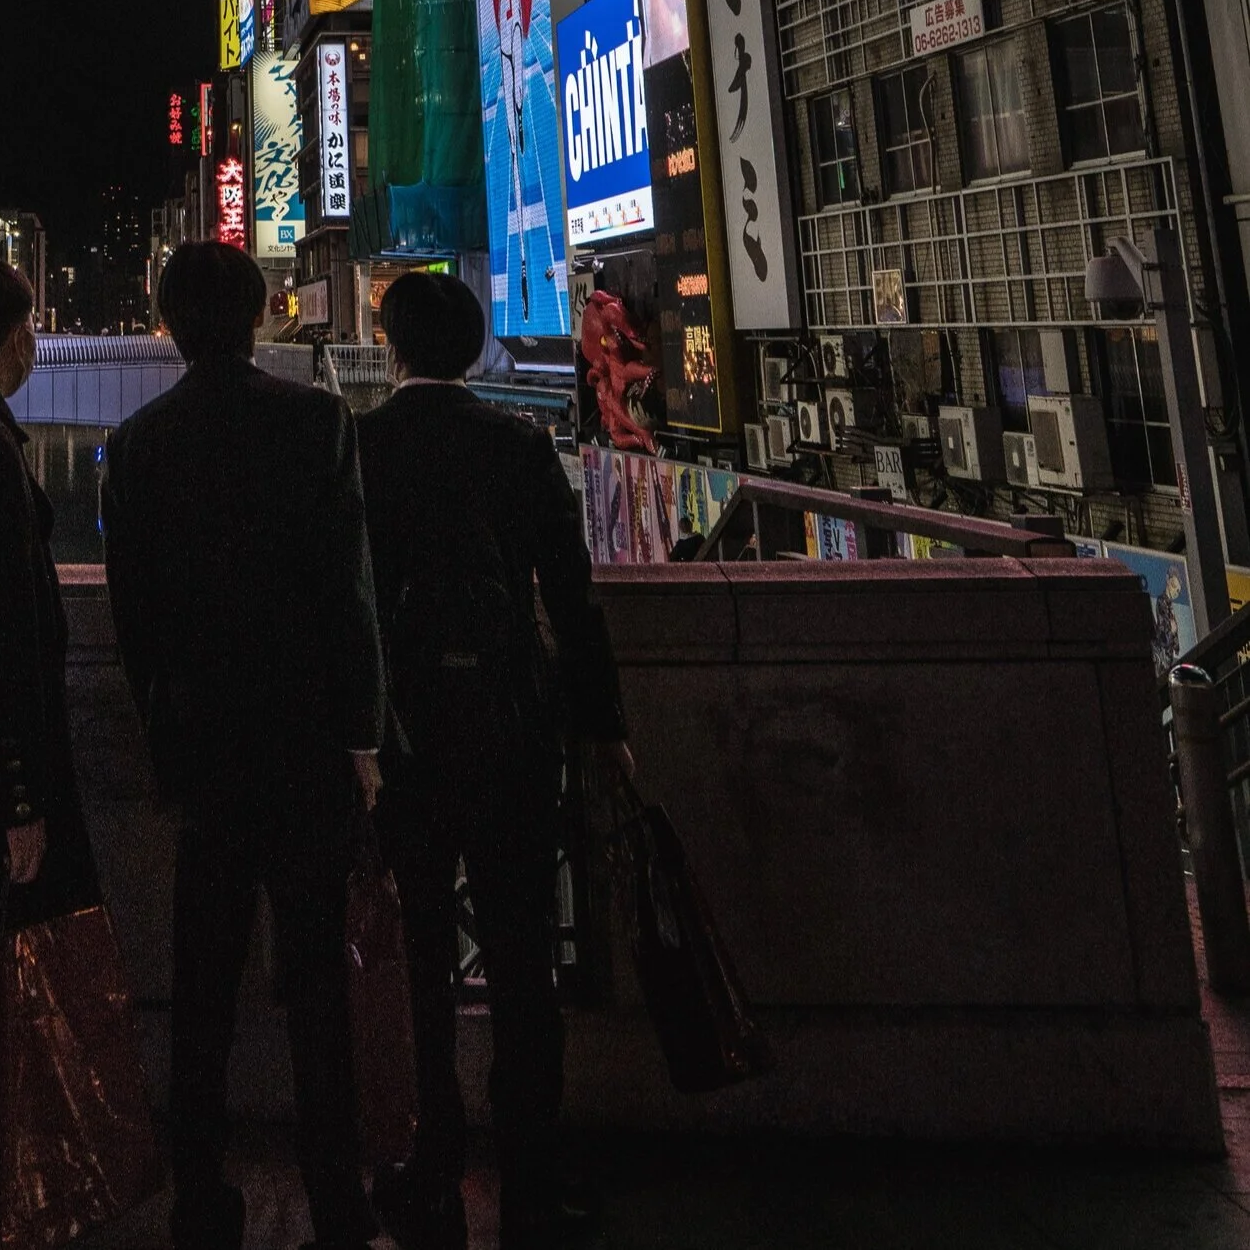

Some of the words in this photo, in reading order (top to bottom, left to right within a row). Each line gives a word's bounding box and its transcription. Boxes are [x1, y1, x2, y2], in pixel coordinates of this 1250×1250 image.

[914, 14, 981, 53] 06-6262-1313
[326, 70, 343, 126] 本場の味
[326, 131, 347, 211] かに道楽
[875, 450, 903, 474] BAR
